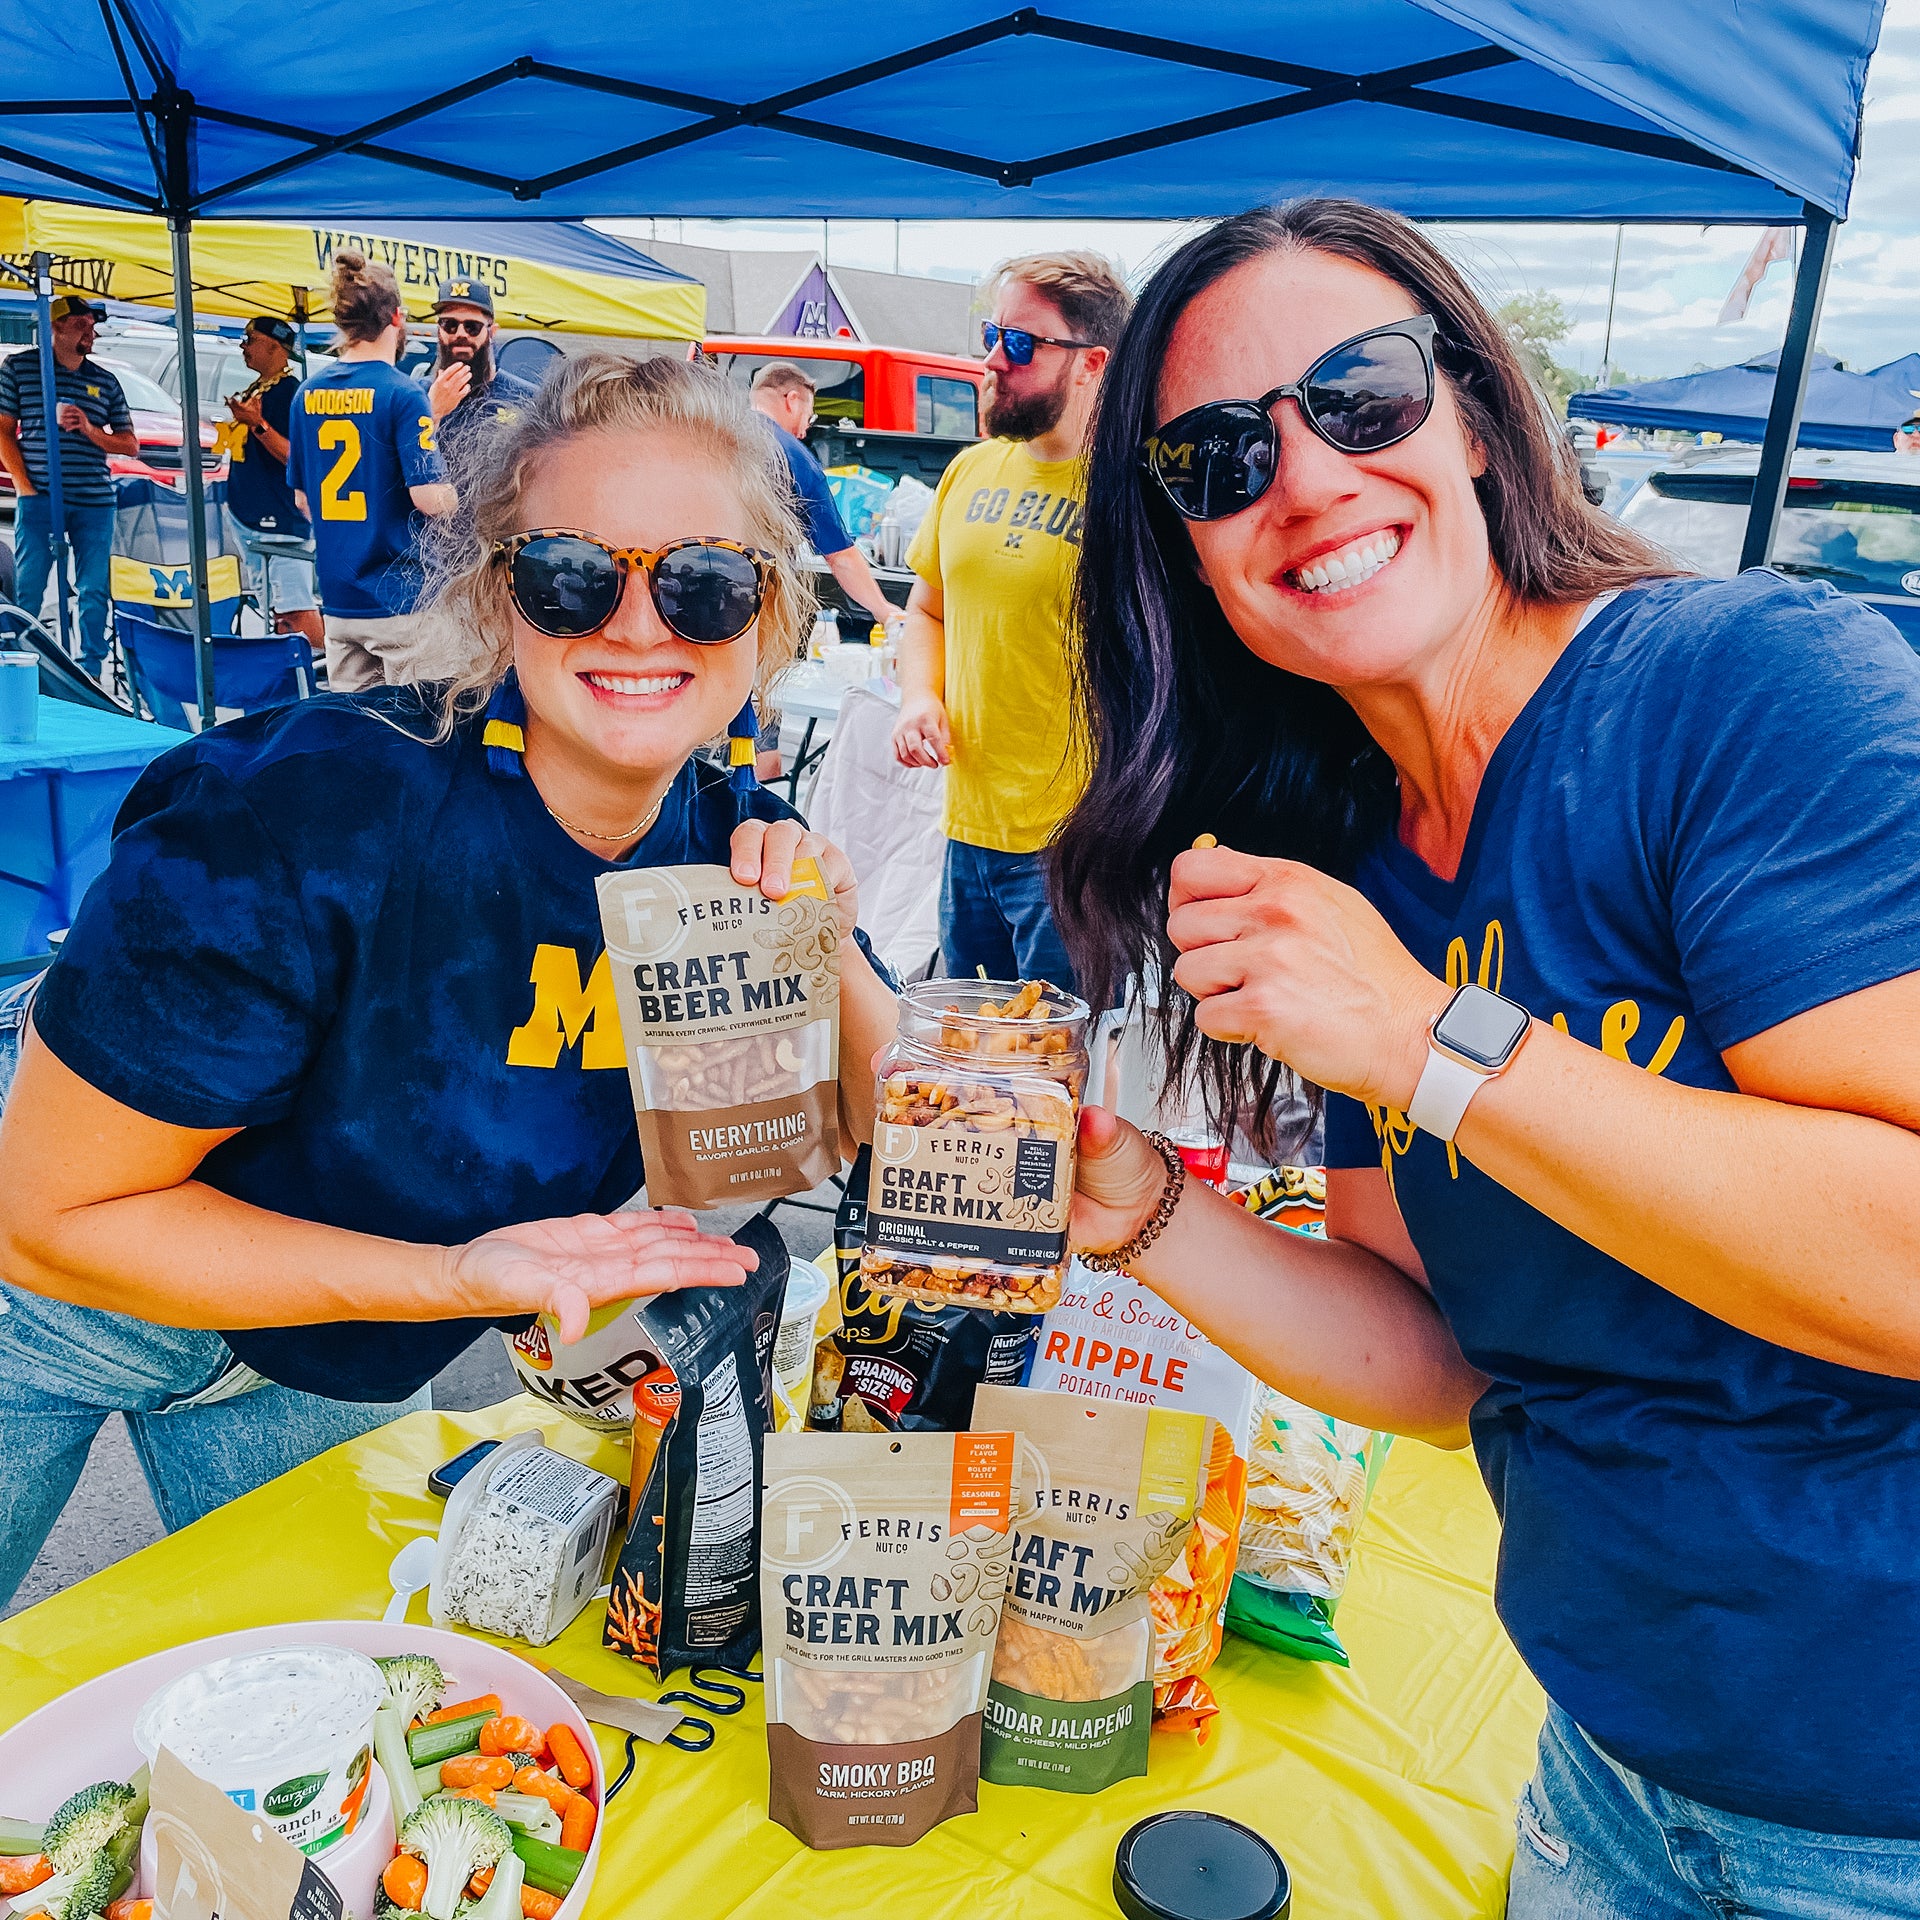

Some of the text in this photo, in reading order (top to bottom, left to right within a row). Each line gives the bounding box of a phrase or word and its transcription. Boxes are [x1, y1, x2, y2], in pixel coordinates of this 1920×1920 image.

[450, 282, 471, 297] M
[304, 388, 375, 415] WOODSON
[418, 416, 435, 451] 2
[318, 419, 367, 521] 2
[965, 488, 1010, 524] GO
[677, 897, 772, 926] FERRIS
[712, 920, 729, 932] NUT
[633, 951, 751, 992] CRAFT
[506, 944, 628, 1069] M
[639, 974, 808, 1023] BEER MIX
[689, 1111, 806, 1151] EVERYTHING
[695, 1150, 734, 1161] SAVORY
[735, 1145, 770, 1157] GARLIC
[780, 1135, 804, 1150] ONION
[930, 1139, 1005, 1160] FERRIS
[955, 1155, 969, 1165] NUT
[882, 1167, 967, 1194] CRAFT
[881, 1188, 1004, 1222] BEER MIX
[878, 1221, 926, 1238] ORIGINAL
[878, 1233, 980, 1252] CLASSIC SALT & PEPPER
[1092, 1291, 1114, 1319] &
[1120, 1299, 1180, 1332] Sour
[1044, 1331, 1189, 1393] RIPPLE
[849, 1360, 913, 1394] SHARING
[858, 1378, 890, 1400] SIZE
[1058, 1373, 1111, 1399] POTATO
[1035, 1489, 1130, 1520] FERRIS
[1066, 1512, 1083, 1524] NUT
[841, 1518, 942, 1543] FERRIS
[876, 1542, 894, 1554] NUT
[782, 1574, 910, 1610] CRAFT
[785, 1606, 880, 1646] BEER
[892, 1608, 964, 1646] MIX
[1008, 1603, 1084, 1632] YOUR HAPPY HOUR
[819, 1654, 834, 1662] FOR
[836, 1654, 850, 1662] THE
[851, 1654, 872, 1662] GRILL
[908, 1654, 924, 1662] AND
[925, 1651, 944, 1661] GOOD
[984, 1721, 1112, 1750] SHARP & CHEESY, MILD HEAT
[1048, 1703, 1133, 1740] JALAPEÑO
[819, 1755, 936, 1788] SMOKY BBQ
[268, 1780, 322, 1808] Marzetti
[815, 1777, 936, 1799] WARM, HICKORY FLAVOR
[287, 1829, 306, 1841] real
